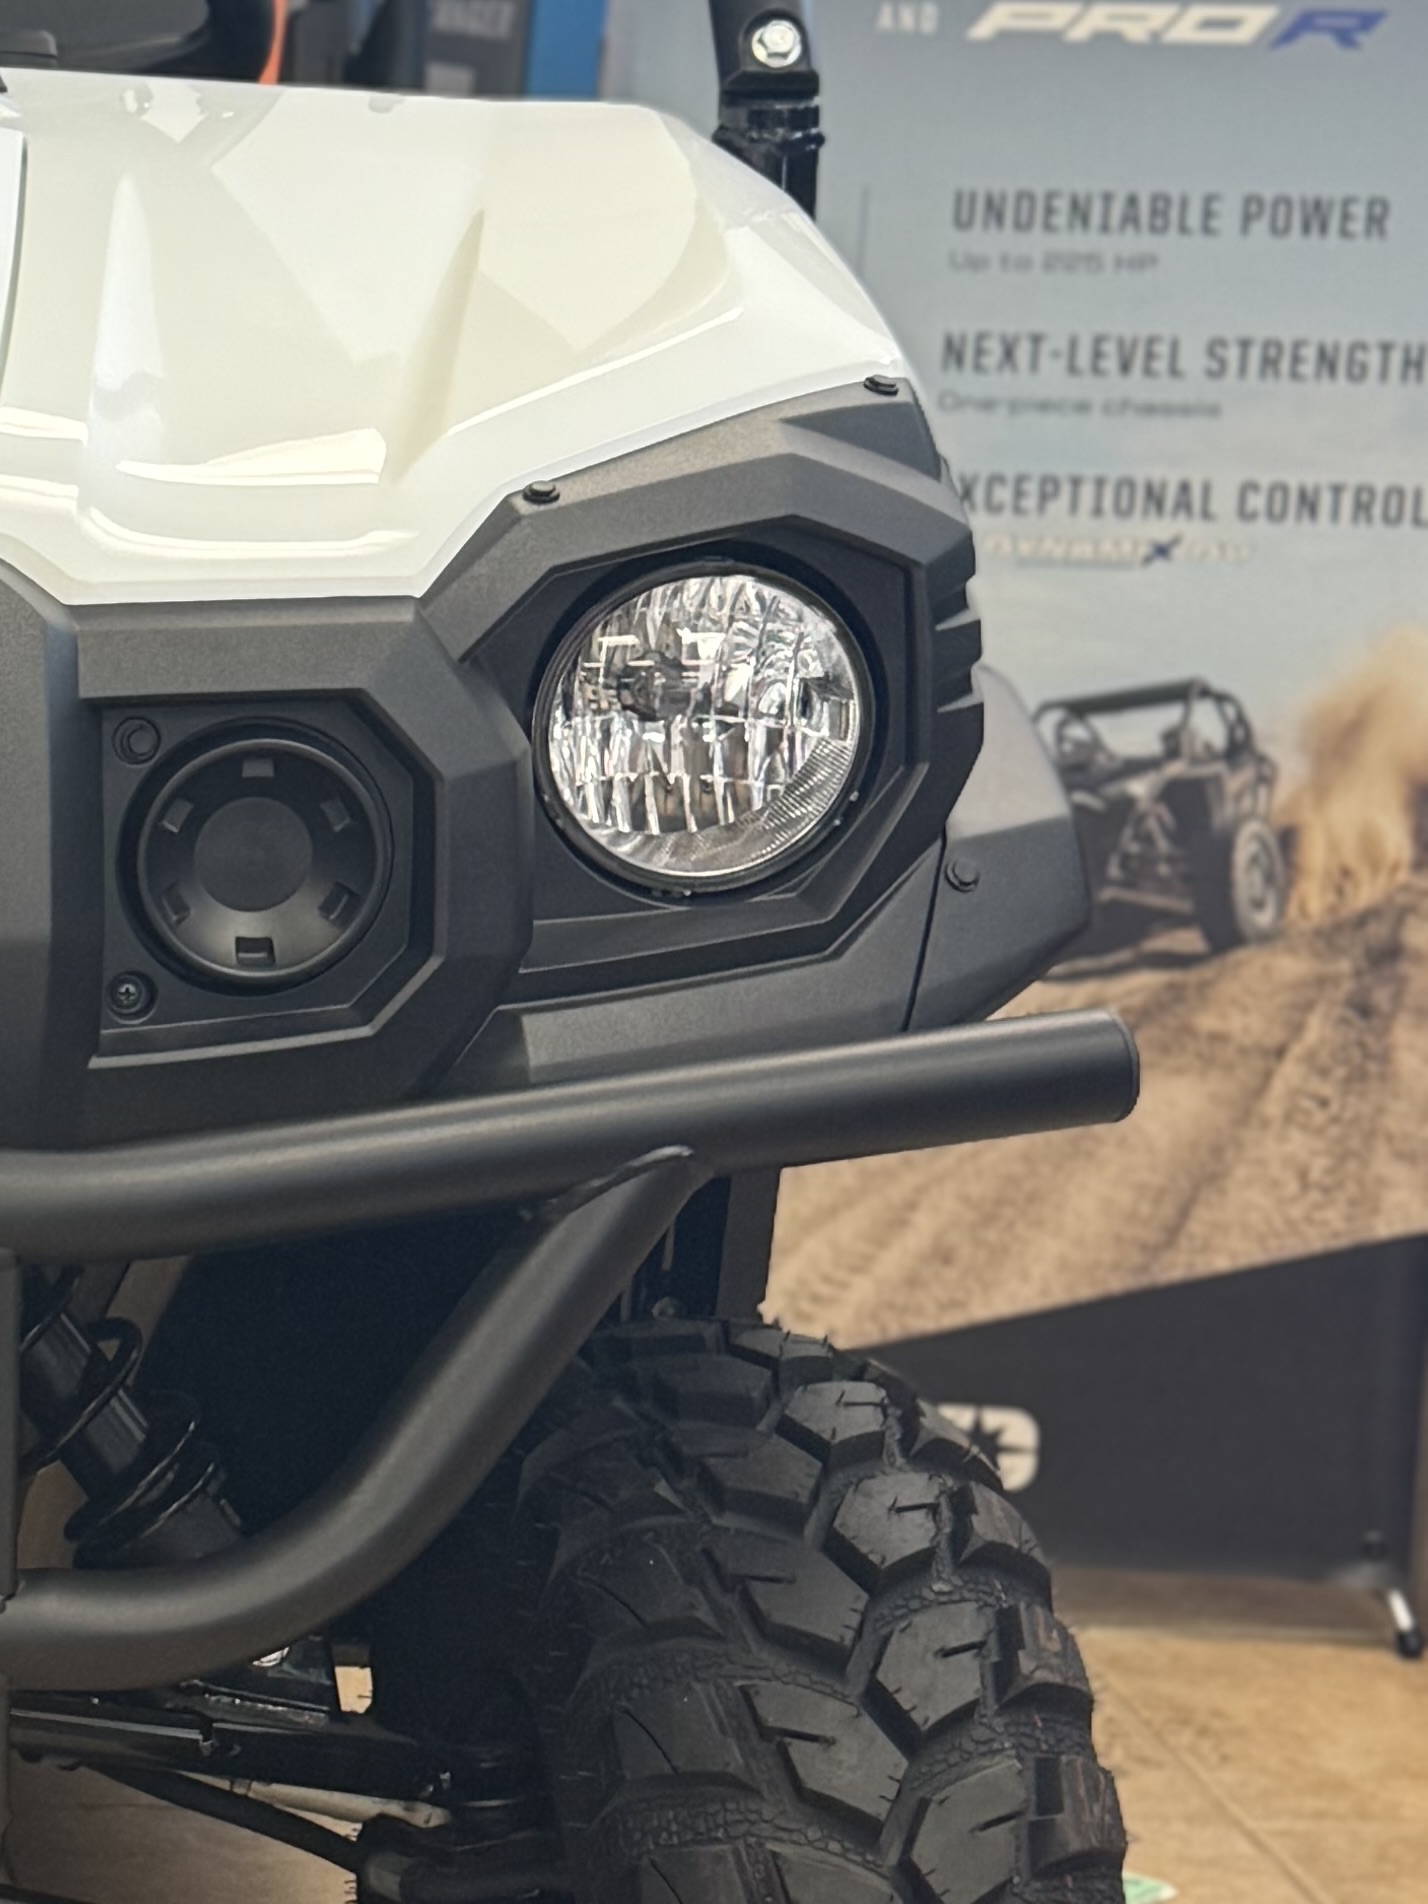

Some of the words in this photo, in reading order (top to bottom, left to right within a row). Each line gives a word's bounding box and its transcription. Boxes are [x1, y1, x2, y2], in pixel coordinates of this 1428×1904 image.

[875, 2, 940, 35] AND
[952, 188, 1221, 237] UNDENIABLE
[1241, 192, 1392, 241] POWER
[941, 332, 1186, 379] NEXT-LEVEL
[1204, 335, 1428, 386] STRENGTH
[958, 472, 1218, 522] XCEPTIONAL
[1235, 479, 1428, 528] CONTROL
